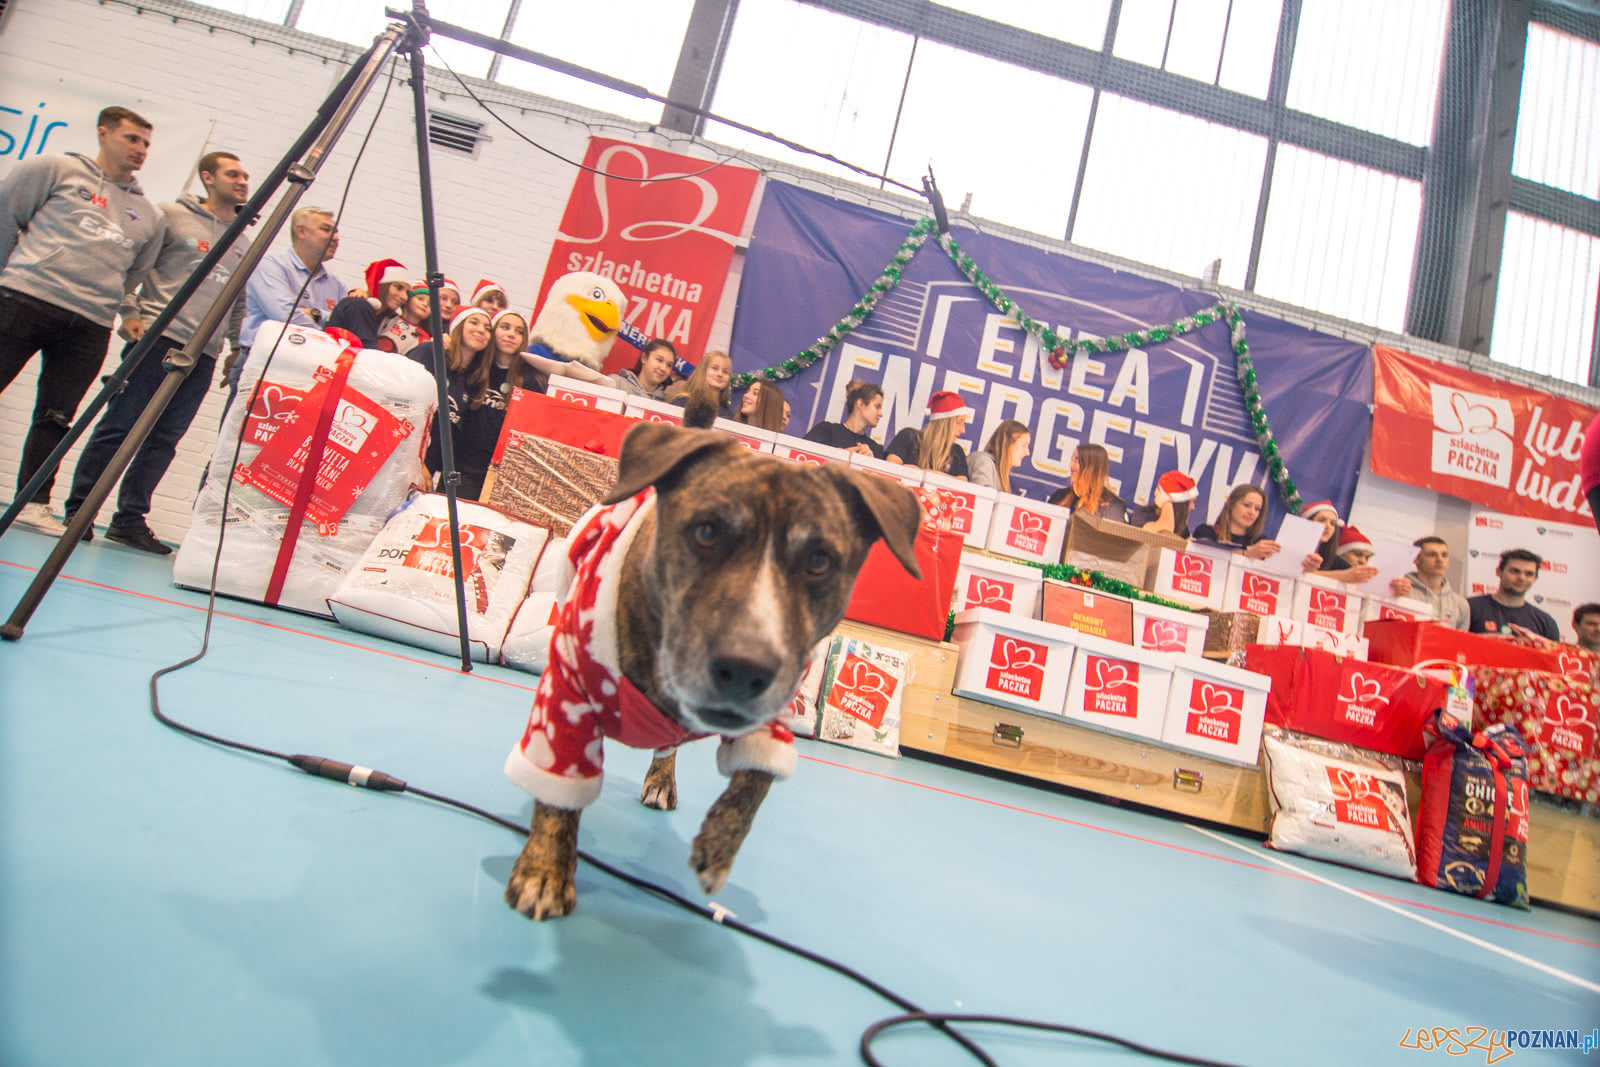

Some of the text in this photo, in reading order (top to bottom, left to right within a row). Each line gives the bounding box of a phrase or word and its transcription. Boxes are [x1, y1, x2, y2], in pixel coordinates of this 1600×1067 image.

[566, 251, 702, 303] szlachetna
[623, 296, 692, 345] ZKA
[976, 313, 1149, 416] ENEA
[1523, 405, 1585, 466] Lub
[1449, 437, 1500, 461] szlachetna
[1447, 449, 1498, 480] PACZKA
[1014, 538, 1038, 551] PACZKA
[997, 677, 1031, 695] PACZKA
[999, 671, 1032, 685] szlachetna
[840, 698, 873, 720] PACZKA
[1095, 699, 1127, 713] PACZKA
[1345, 710, 1375, 727] PACZKA
[1198, 722, 1229, 739] PACZKA
[1551, 732, 1583, 752] PACZKA
[1347, 809, 1379, 825] PACZKA
